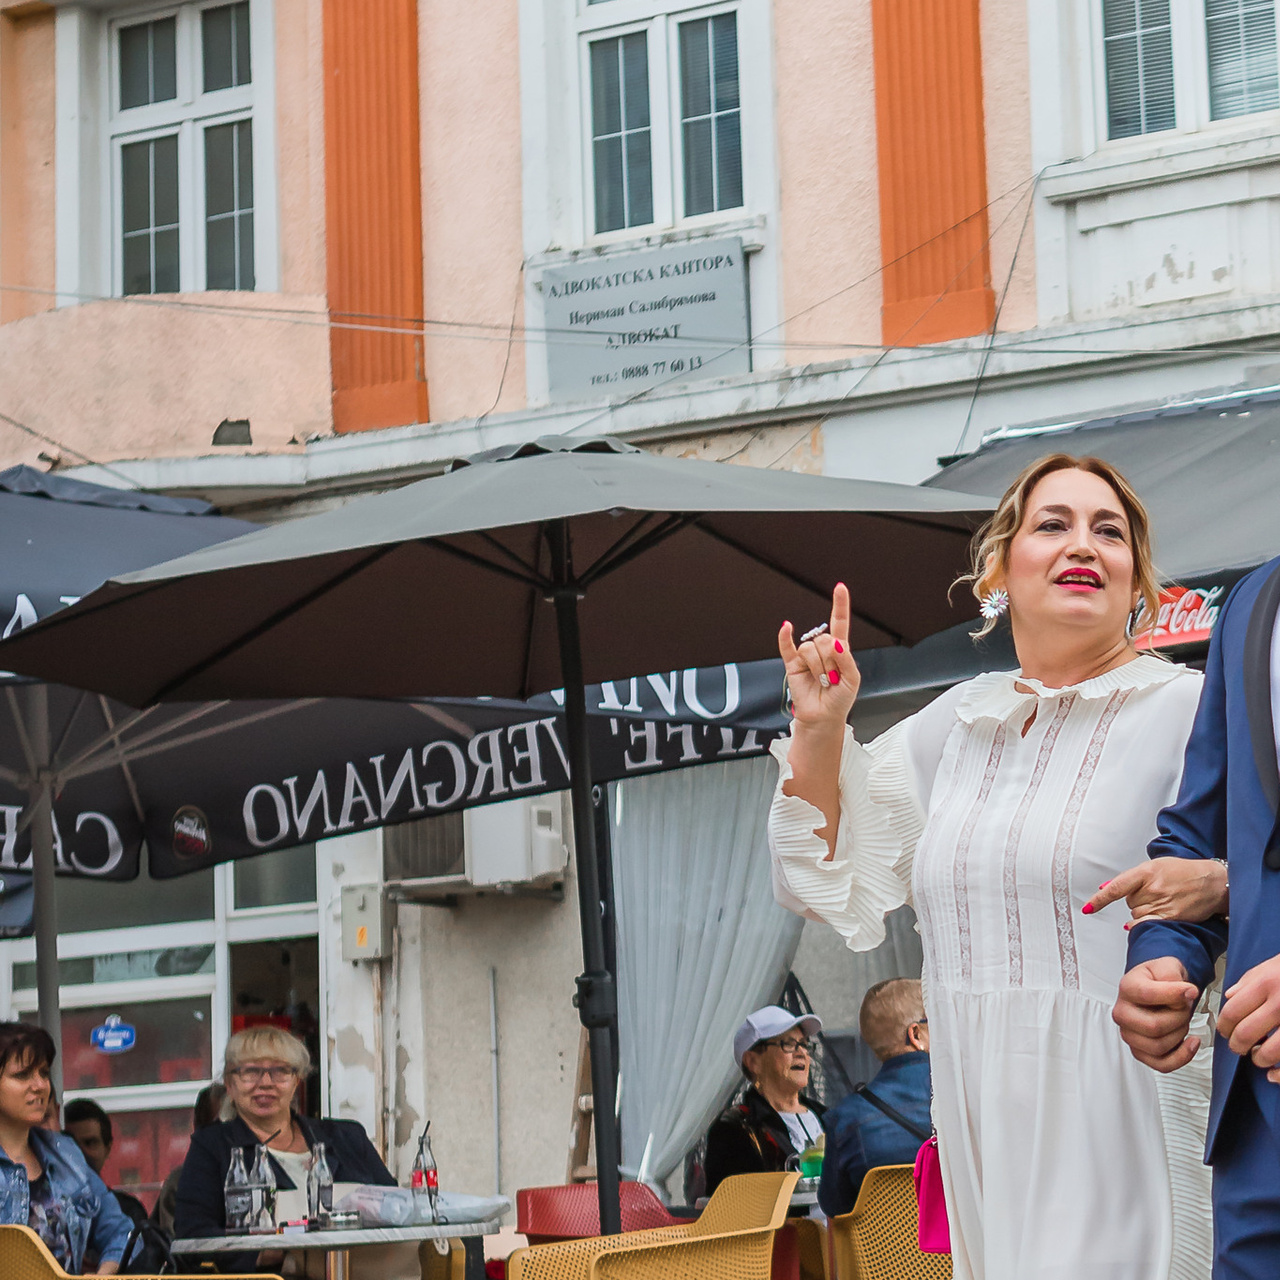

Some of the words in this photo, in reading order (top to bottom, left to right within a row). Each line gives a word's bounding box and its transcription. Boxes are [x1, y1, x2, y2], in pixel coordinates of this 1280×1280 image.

[548, 267, 655, 299] АДВОКАТСКА
[659, 254, 735, 279] КАНТОРА
[569, 305, 625, 326] Нериман
[605, 323, 682, 350] АДВОКАТ
[621, 363, 650, 380] 0888
[652, 360, 667, 376] 77
[689, 355, 703, 372] 13
